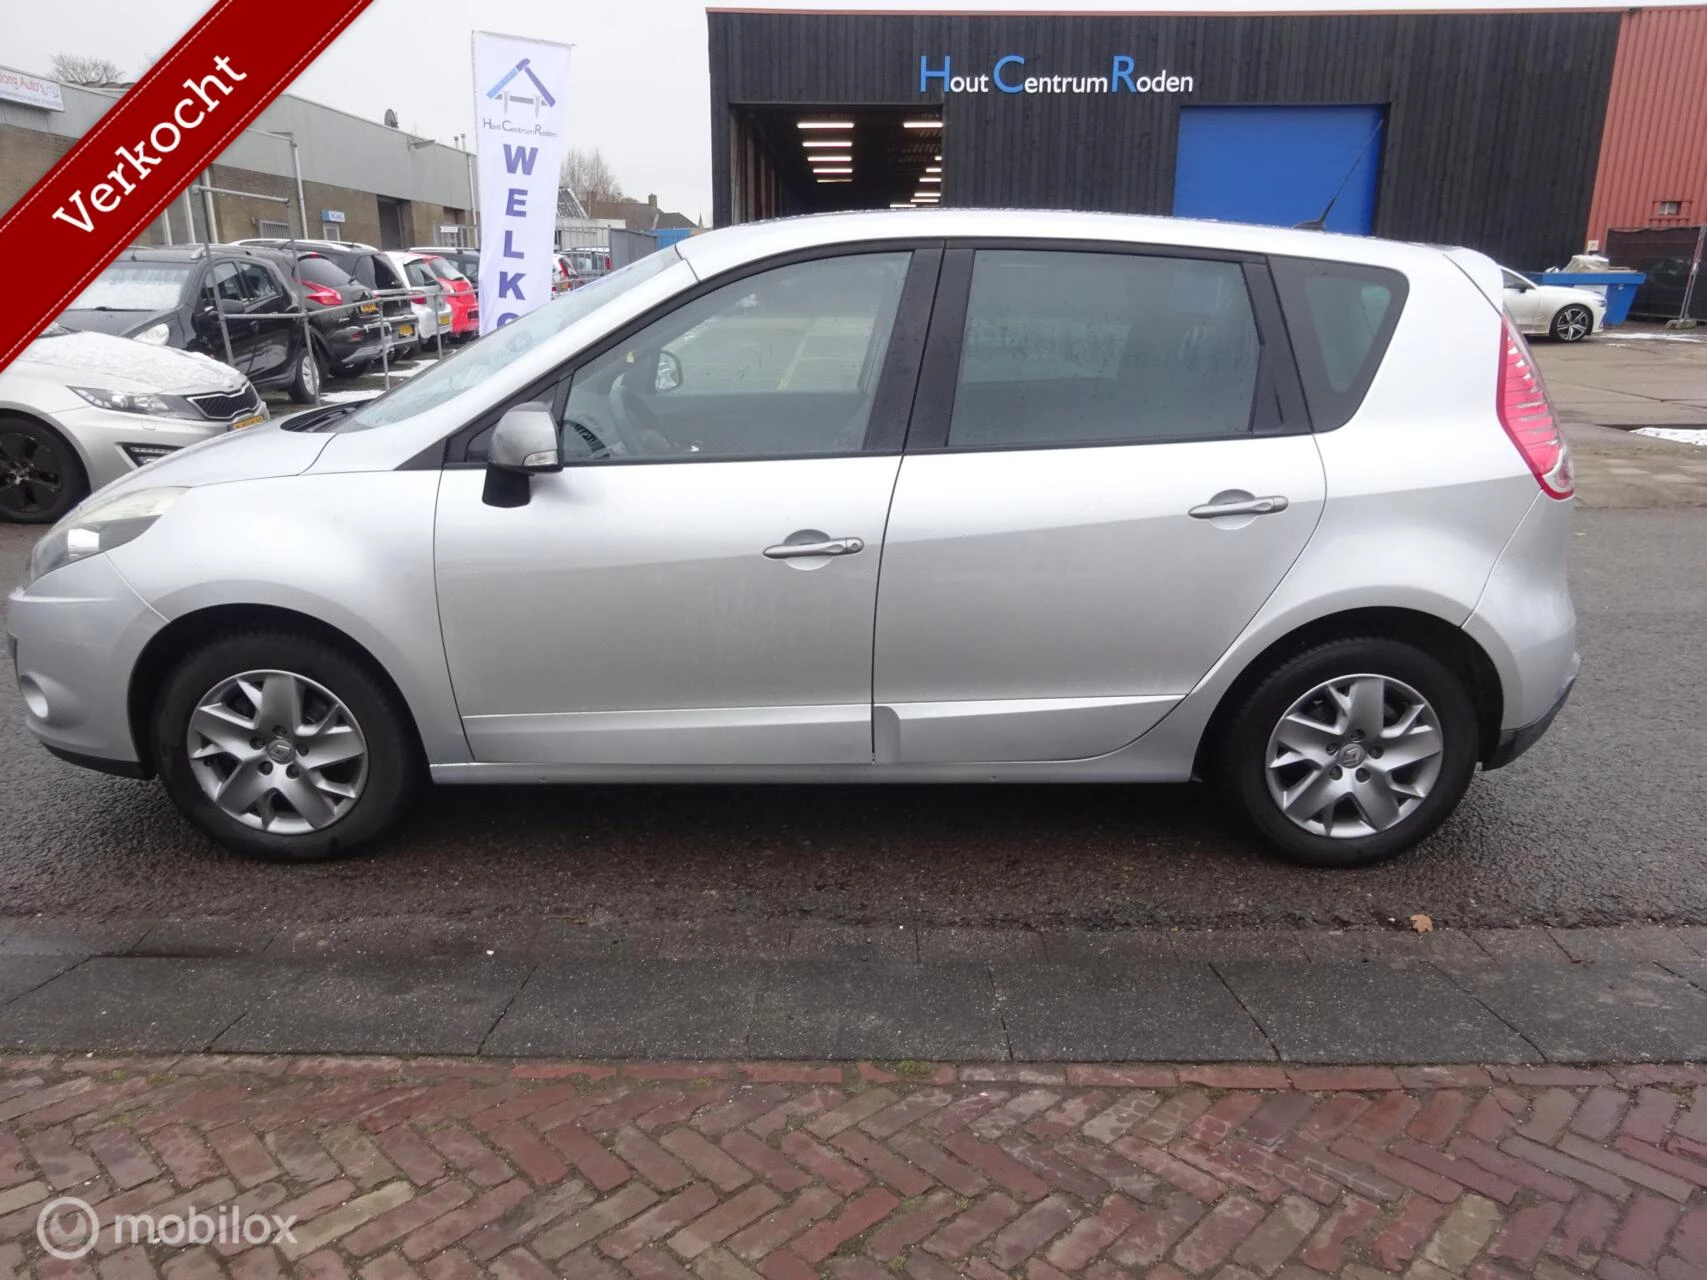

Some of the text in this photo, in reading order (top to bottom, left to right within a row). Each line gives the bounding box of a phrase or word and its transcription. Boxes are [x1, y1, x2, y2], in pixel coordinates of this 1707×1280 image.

[920, 55, 1194, 94] Hout Centrum Roden
